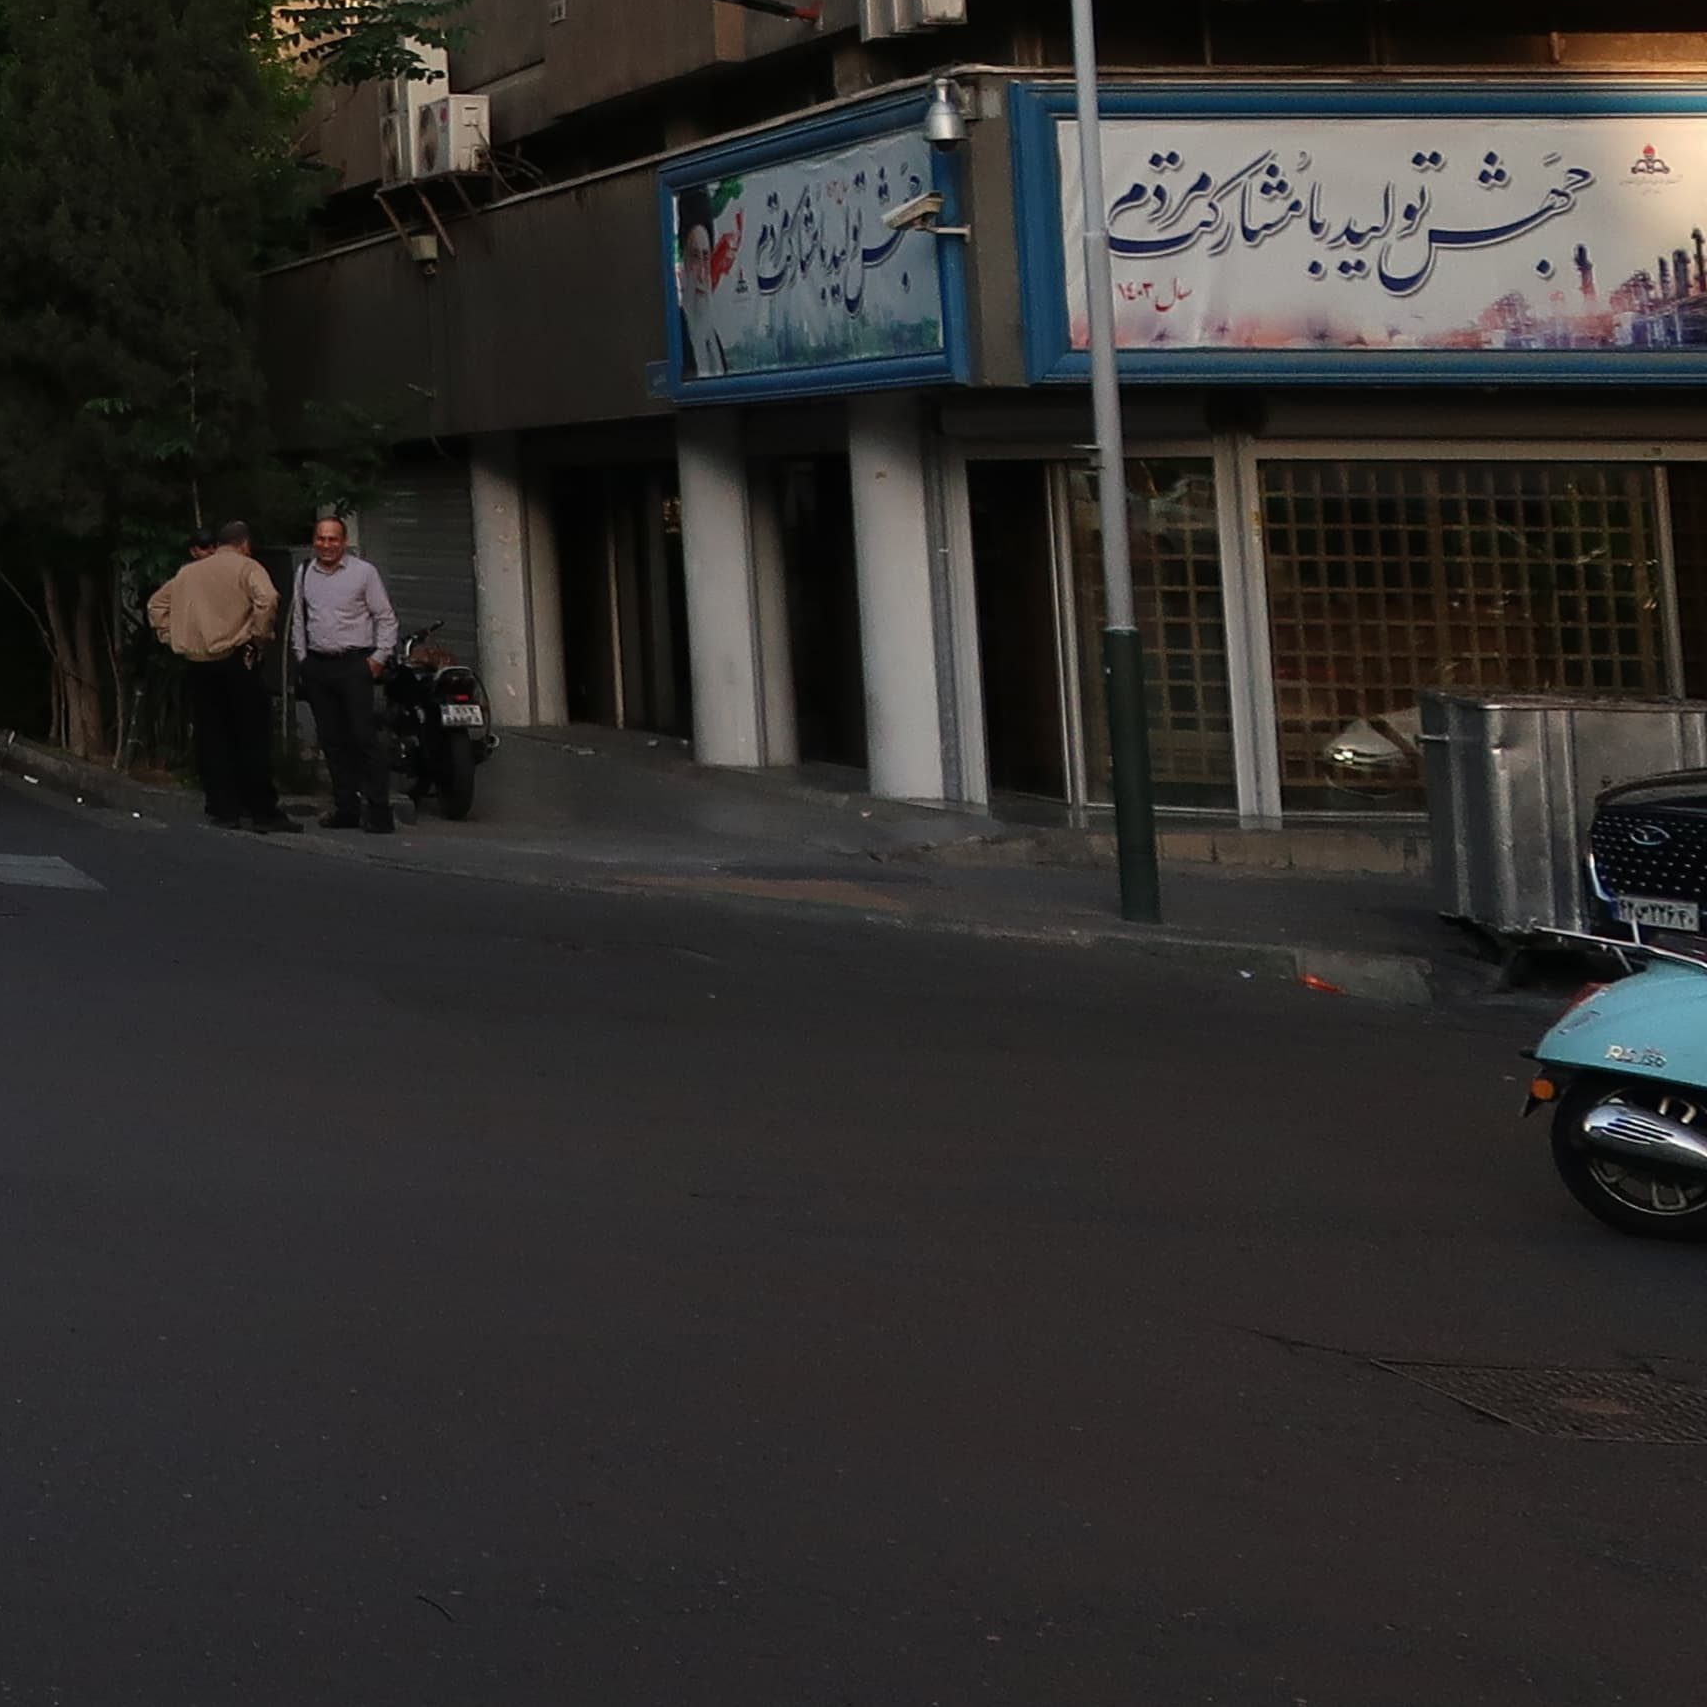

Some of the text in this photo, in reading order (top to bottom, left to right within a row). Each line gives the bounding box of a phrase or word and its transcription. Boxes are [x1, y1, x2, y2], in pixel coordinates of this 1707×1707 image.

[1108, 171, 1213, 229] مردم
[1305, 180, 1331, 277] با
[1326, 151, 1441, 277] تولید
[1154, 277, 1193, 312] سال
